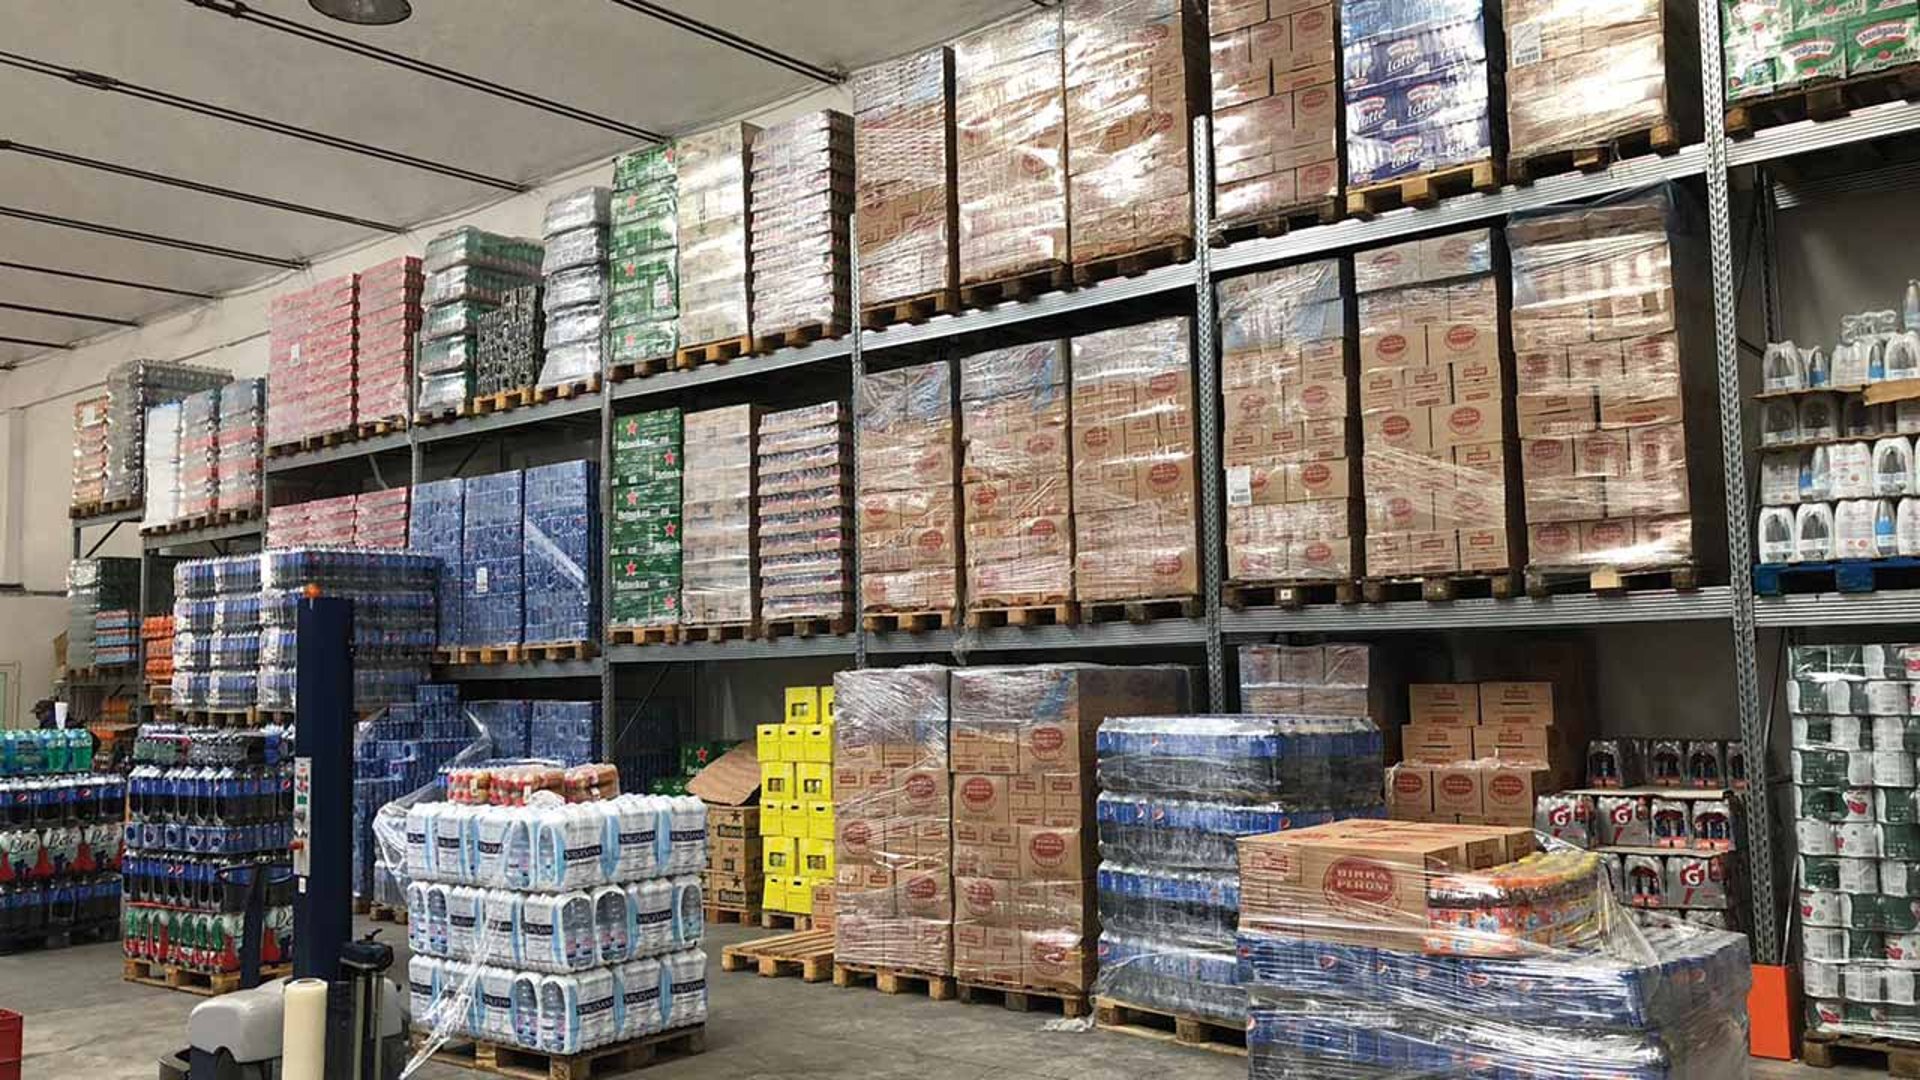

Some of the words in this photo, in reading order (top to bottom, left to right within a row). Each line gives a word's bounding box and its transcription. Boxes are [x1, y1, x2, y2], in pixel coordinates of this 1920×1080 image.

[1553, 811, 1567, 826] G
[1615, 810, 1629, 825] G
[1336, 869, 1387, 880] BIRRA
[1684, 870, 1700, 886] G
[1336, 880, 1389, 891] PERONI
